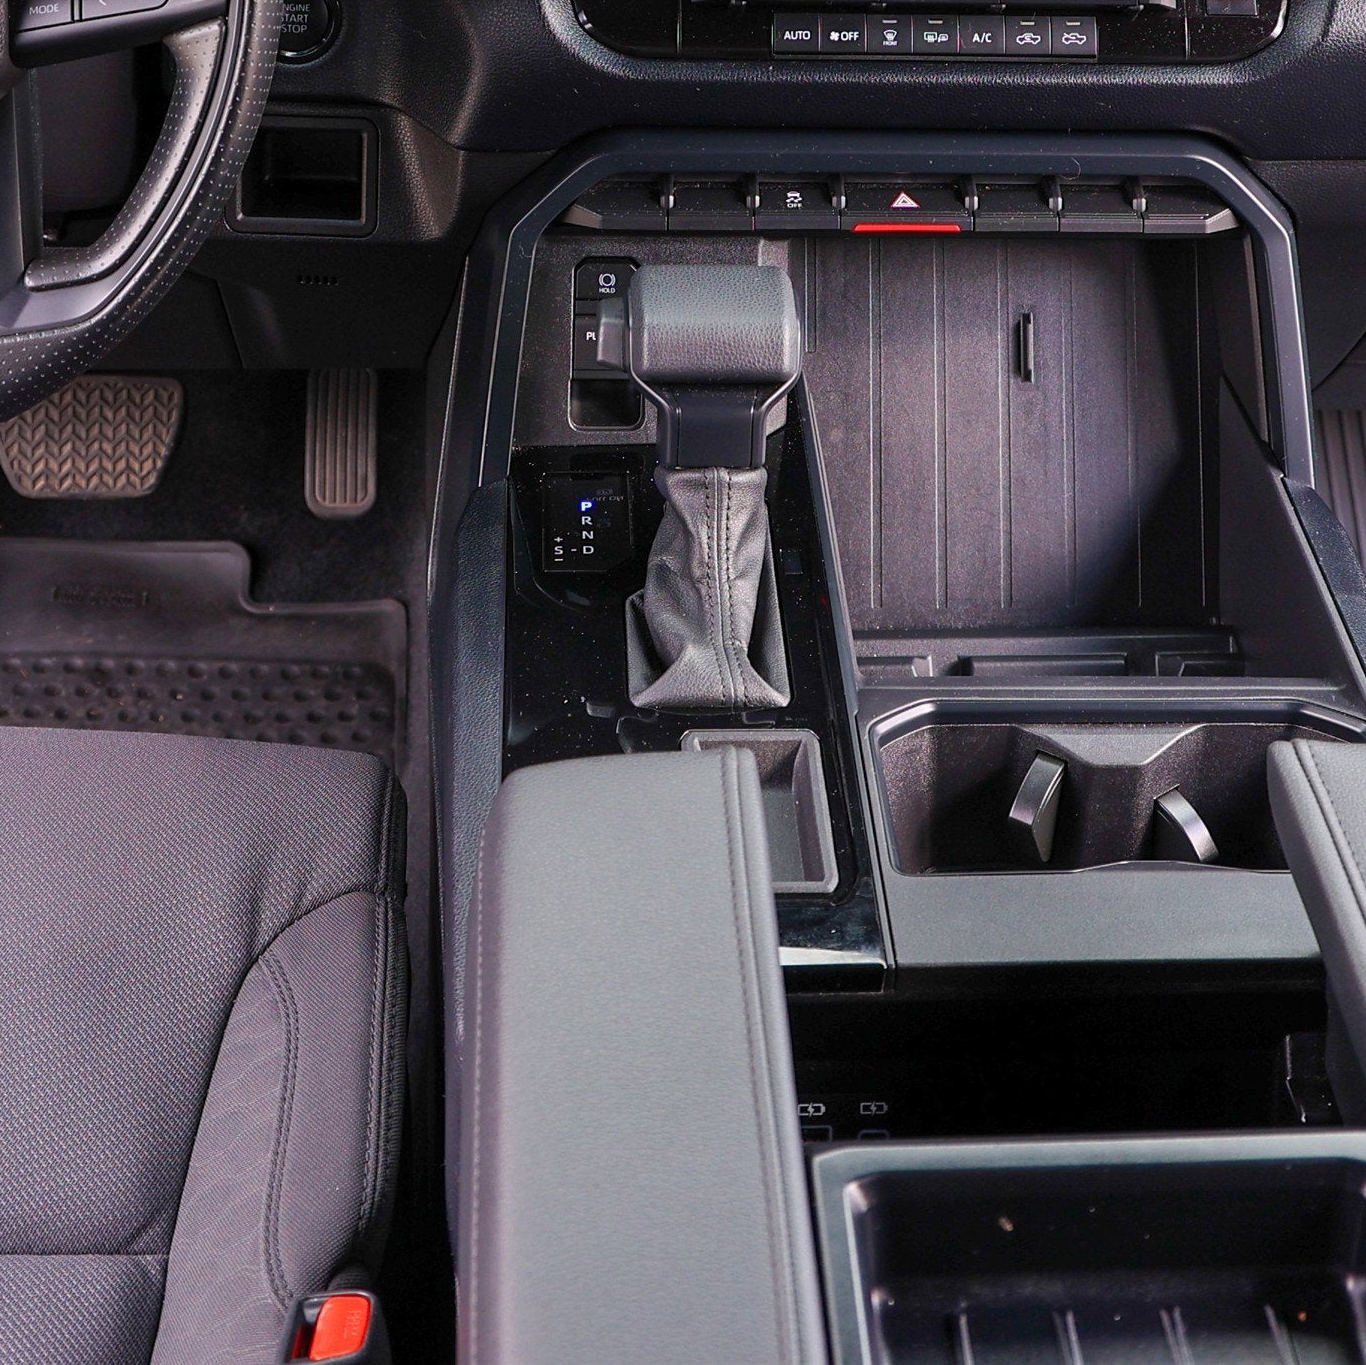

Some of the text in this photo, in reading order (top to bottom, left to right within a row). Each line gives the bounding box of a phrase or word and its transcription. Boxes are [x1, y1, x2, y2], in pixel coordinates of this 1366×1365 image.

[29, 3, 59, 15] MODE
[283, 3, 311, 12] NGINE
[281, 23, 307, 33] STOP
[783, 30, 811, 41] AUTO
[840, 31, 859, 41] OFF
[973, 32, 992, 43] A/C
[581, 501, 593, 512] P
[581, 516, 593, 525] R
[582, 531, 594, 539] N
[554, 545, 563, 555] S
[583, 545, 595, 555] D
